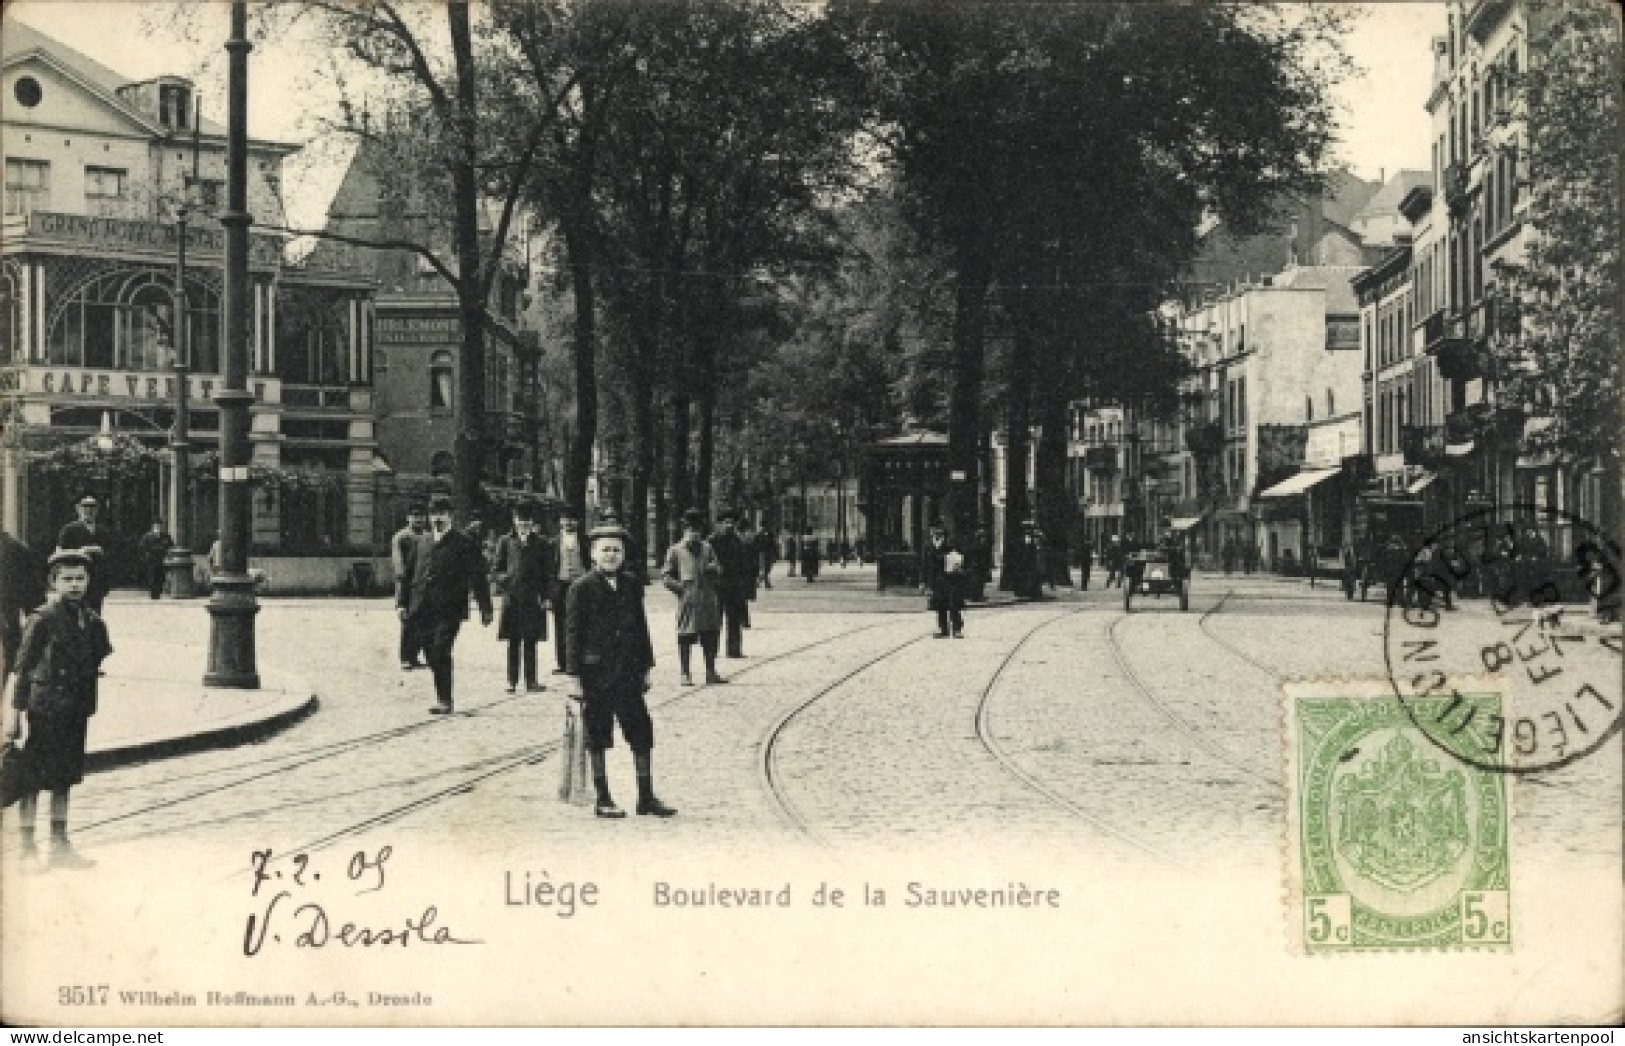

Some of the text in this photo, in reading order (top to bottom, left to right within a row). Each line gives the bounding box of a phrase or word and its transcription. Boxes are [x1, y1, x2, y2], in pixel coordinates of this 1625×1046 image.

[504, 869, 1061, 918] Liège Boulevard de la Sauvenière
[117, 990, 197, 1007] Wilhelm
[206, 990, 296, 1007] Hoffmann
[366, 990, 433, 1007] Dresde
